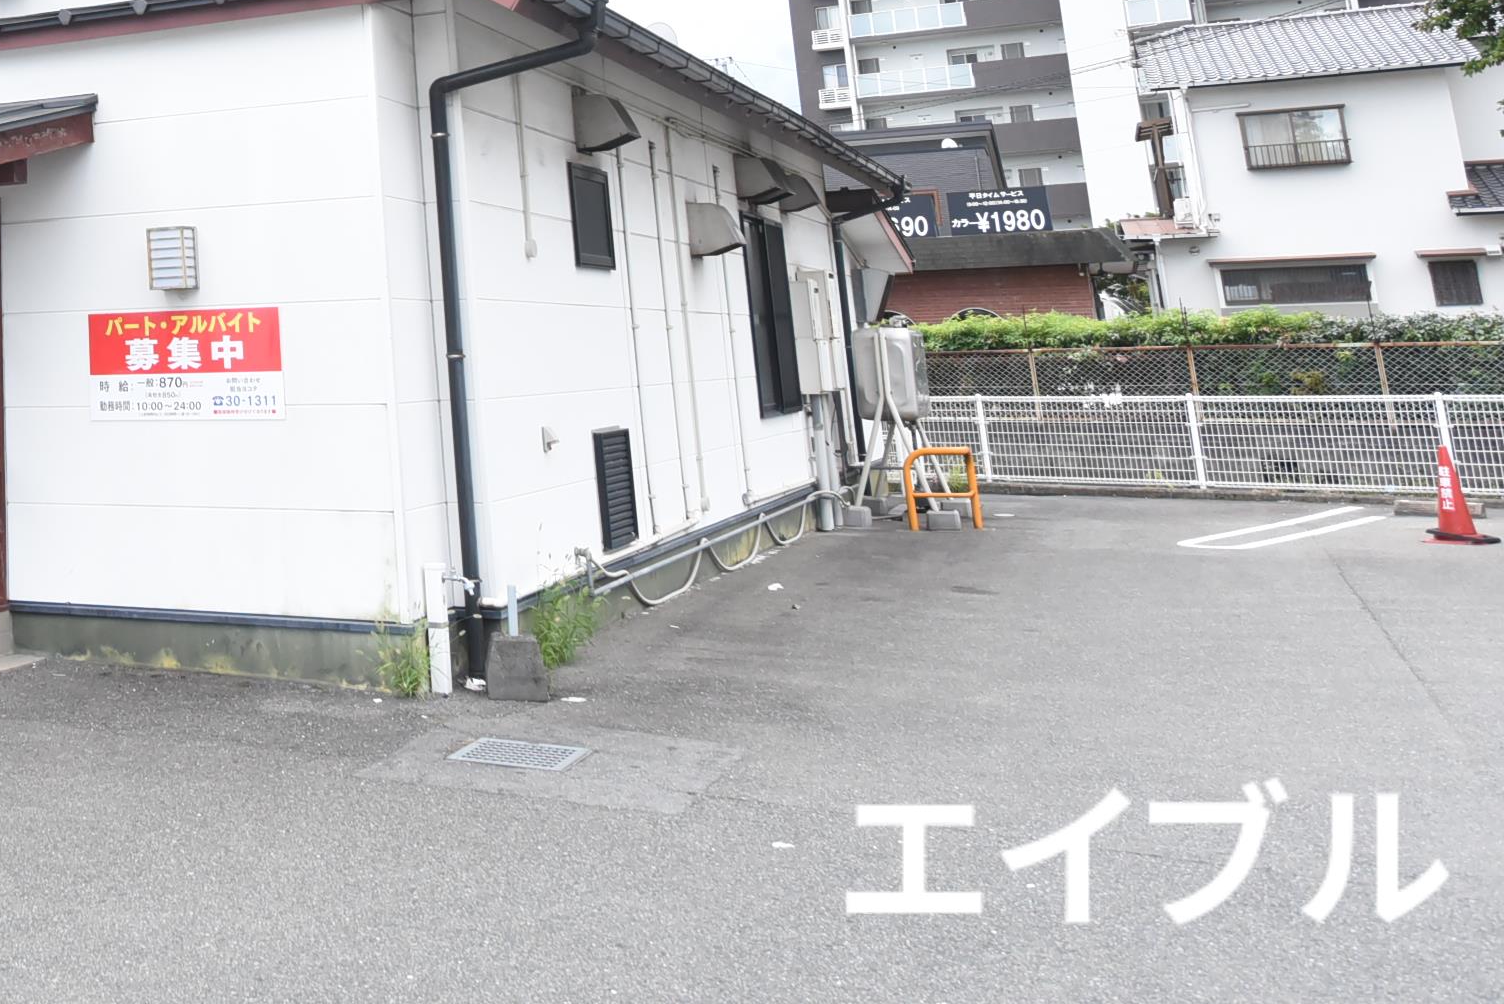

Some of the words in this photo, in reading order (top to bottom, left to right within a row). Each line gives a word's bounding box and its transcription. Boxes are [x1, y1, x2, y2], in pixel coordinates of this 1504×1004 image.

[105, 312, 261, 336] パート・アルバイト
[125, 335, 244, 371] 募集中
